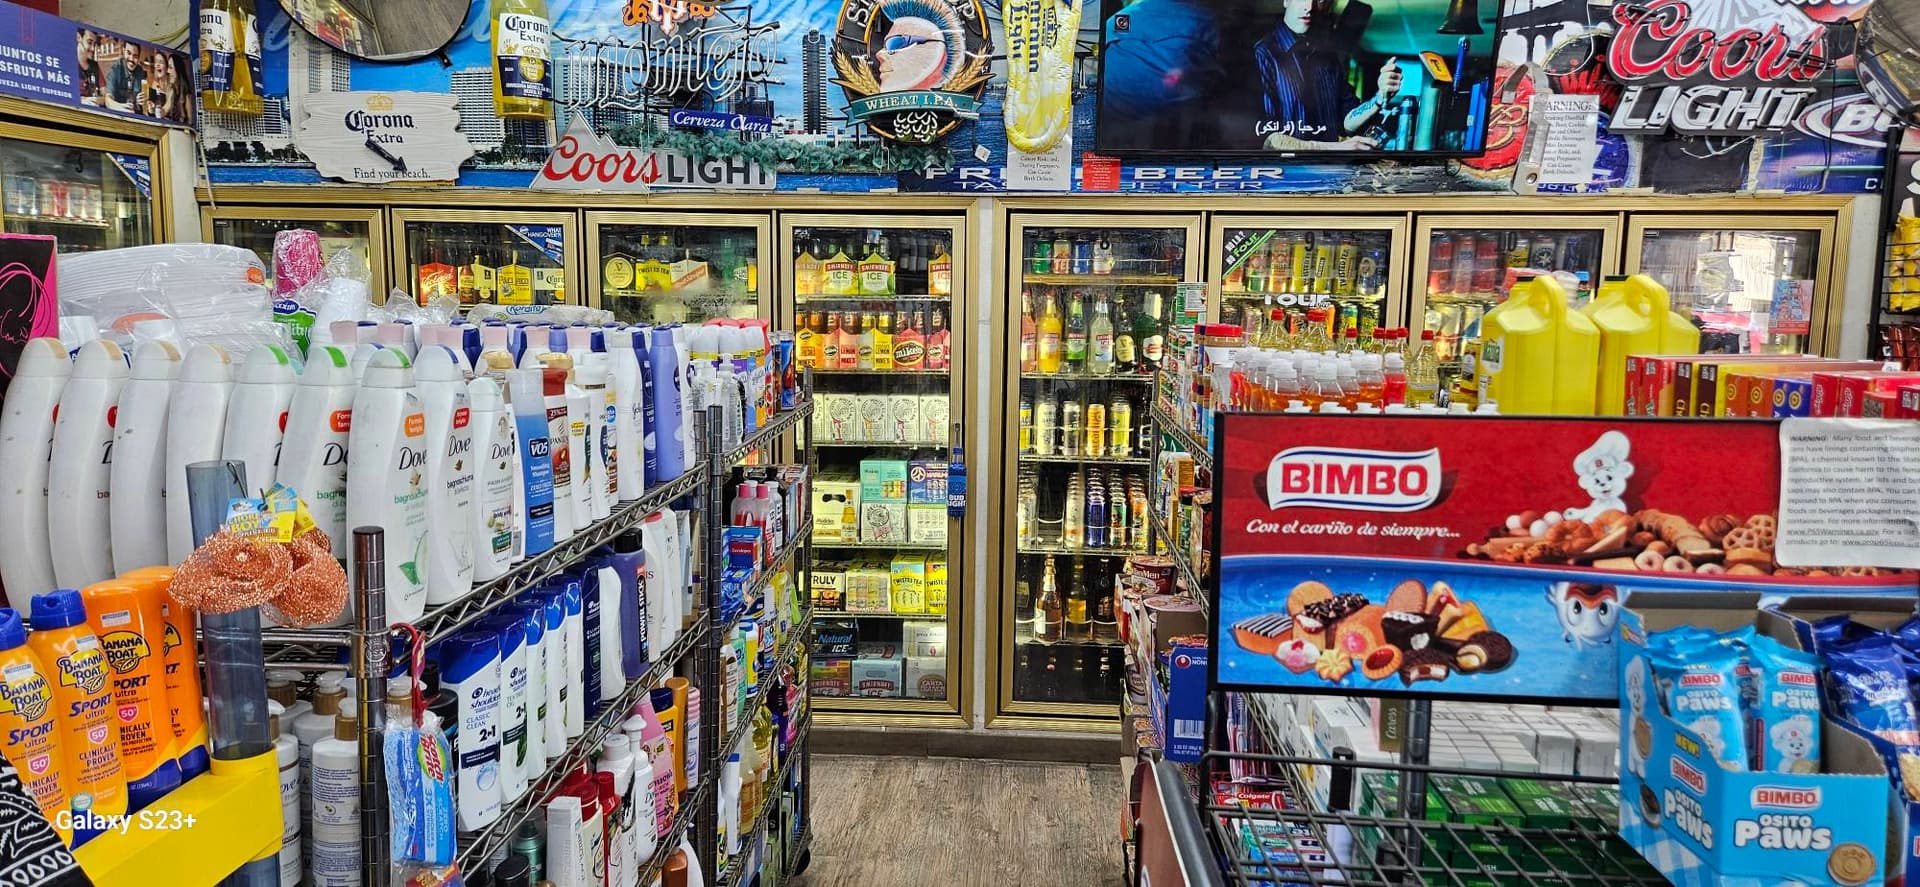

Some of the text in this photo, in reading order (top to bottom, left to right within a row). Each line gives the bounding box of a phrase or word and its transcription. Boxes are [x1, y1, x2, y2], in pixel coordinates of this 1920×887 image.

[1609, 0, 1828, 82] Coors
[46, 56, 60, 69] SE
[47, 69, 70, 86] MÁS
[21, 82, 72, 98] LIGHT SUPERIOR
[865, 95, 918, 111] WHEAT
[1609, 84, 1817, 133] LIGHT
[345, 110, 414, 134] Corona
[674, 111, 769, 132] Cerveza Clara
[366, 130, 404, 144] Extra
[543, 136, 769, 185] Coors LIGHT
[354, 168, 431, 180] Find your beach.
[1134, 167, 1284, 180] BEER
[1713, 231, 1736, 252] 11
[832, 271, 848, 279] ICE
[448, 435, 471, 457] Dove
[491, 443, 512, 460] Dove
[530, 441, 548, 456] VO5
[399, 446, 427, 470] Dove
[1281, 462, 1428, 497] BIMBO
[1246, 518, 1460, 540] Con el cariño de siempre...
[817, 633, 852, 643] Natural
[831, 644, 848, 653] ICE
[60, 654, 103, 674] BANANA
[107, 651, 137, 664] BOAT
[73, 665, 102, 684] BOAT
[1681, 673, 1721, 685] BIMBO
[0, 678, 46, 701] BANANA
[115, 688, 137, 698] ultra
[1686, 690, 1718, 699] OSITO
[11, 692, 43, 712] BOAT
[69, 693, 112, 717] SPORT
[1676, 695, 1732, 711] Paws
[85, 709, 105, 719] ultra
[466, 720, 486, 731] CLEAN
[1386, 707, 1397, 739] Caress
[8, 720, 55, 746] SPORT
[25, 736, 46, 749] ultra
[79, 742, 117, 760] CLINICALLY
[1675, 733, 1700, 758] NEW!
[87, 752, 115, 767] PROVEN
[1671, 759, 1704, 791] BIMBO
[1675, 788, 1702, 817] OSITO
[1756, 789, 1817, 804] BIMBO
[1664, 788, 1713, 850] Paws
[1760, 814, 1812, 827] OSITO
[1734, 819, 1832, 850] Paws
